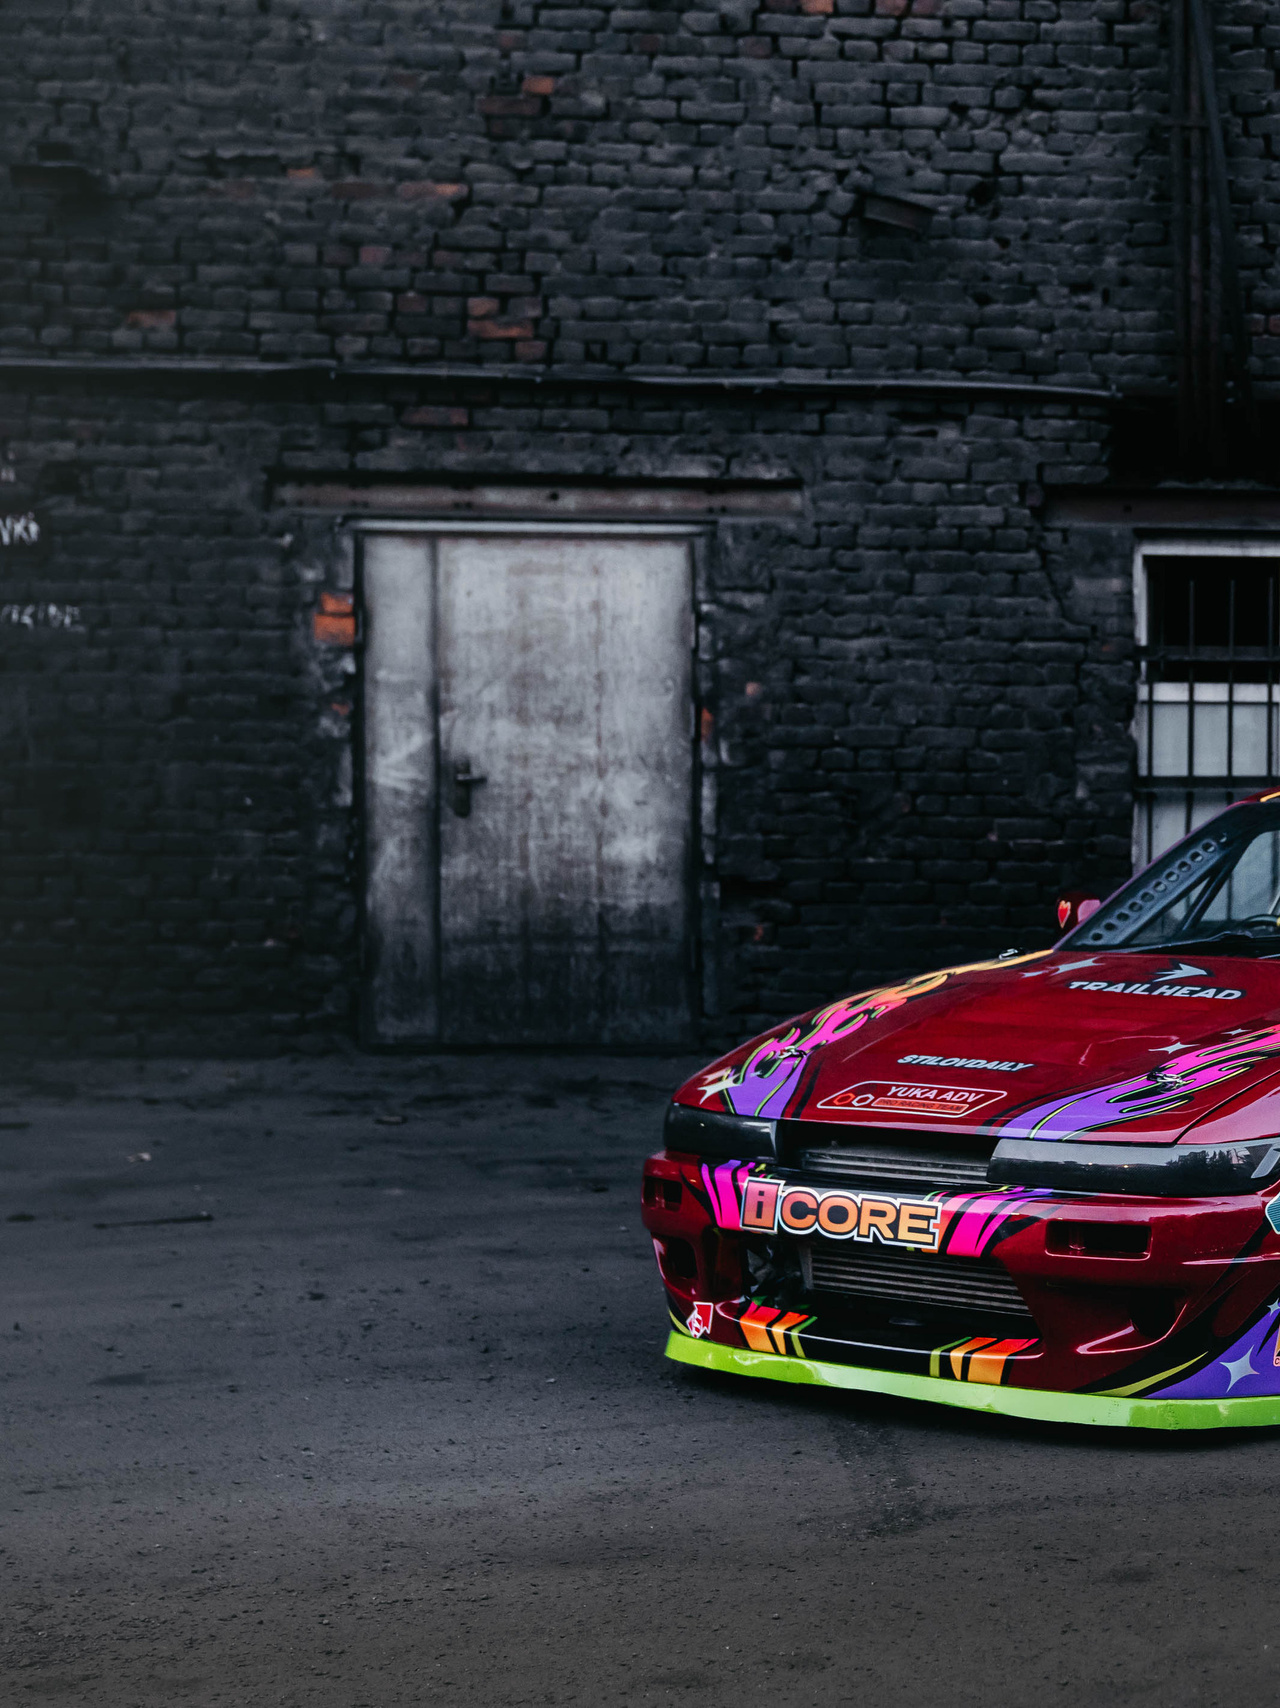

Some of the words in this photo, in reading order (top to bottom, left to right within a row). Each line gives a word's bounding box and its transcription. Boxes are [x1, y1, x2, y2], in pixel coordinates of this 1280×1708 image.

[1069, 981, 1242, 1000] TRAILHEAD
[897, 1054, 1034, 1072] STILOVDAILY
[887, 1086, 941, 1099] YUKA
[936, 1090, 985, 1103] ADV
[900, 1100, 934, 1109] RACING
